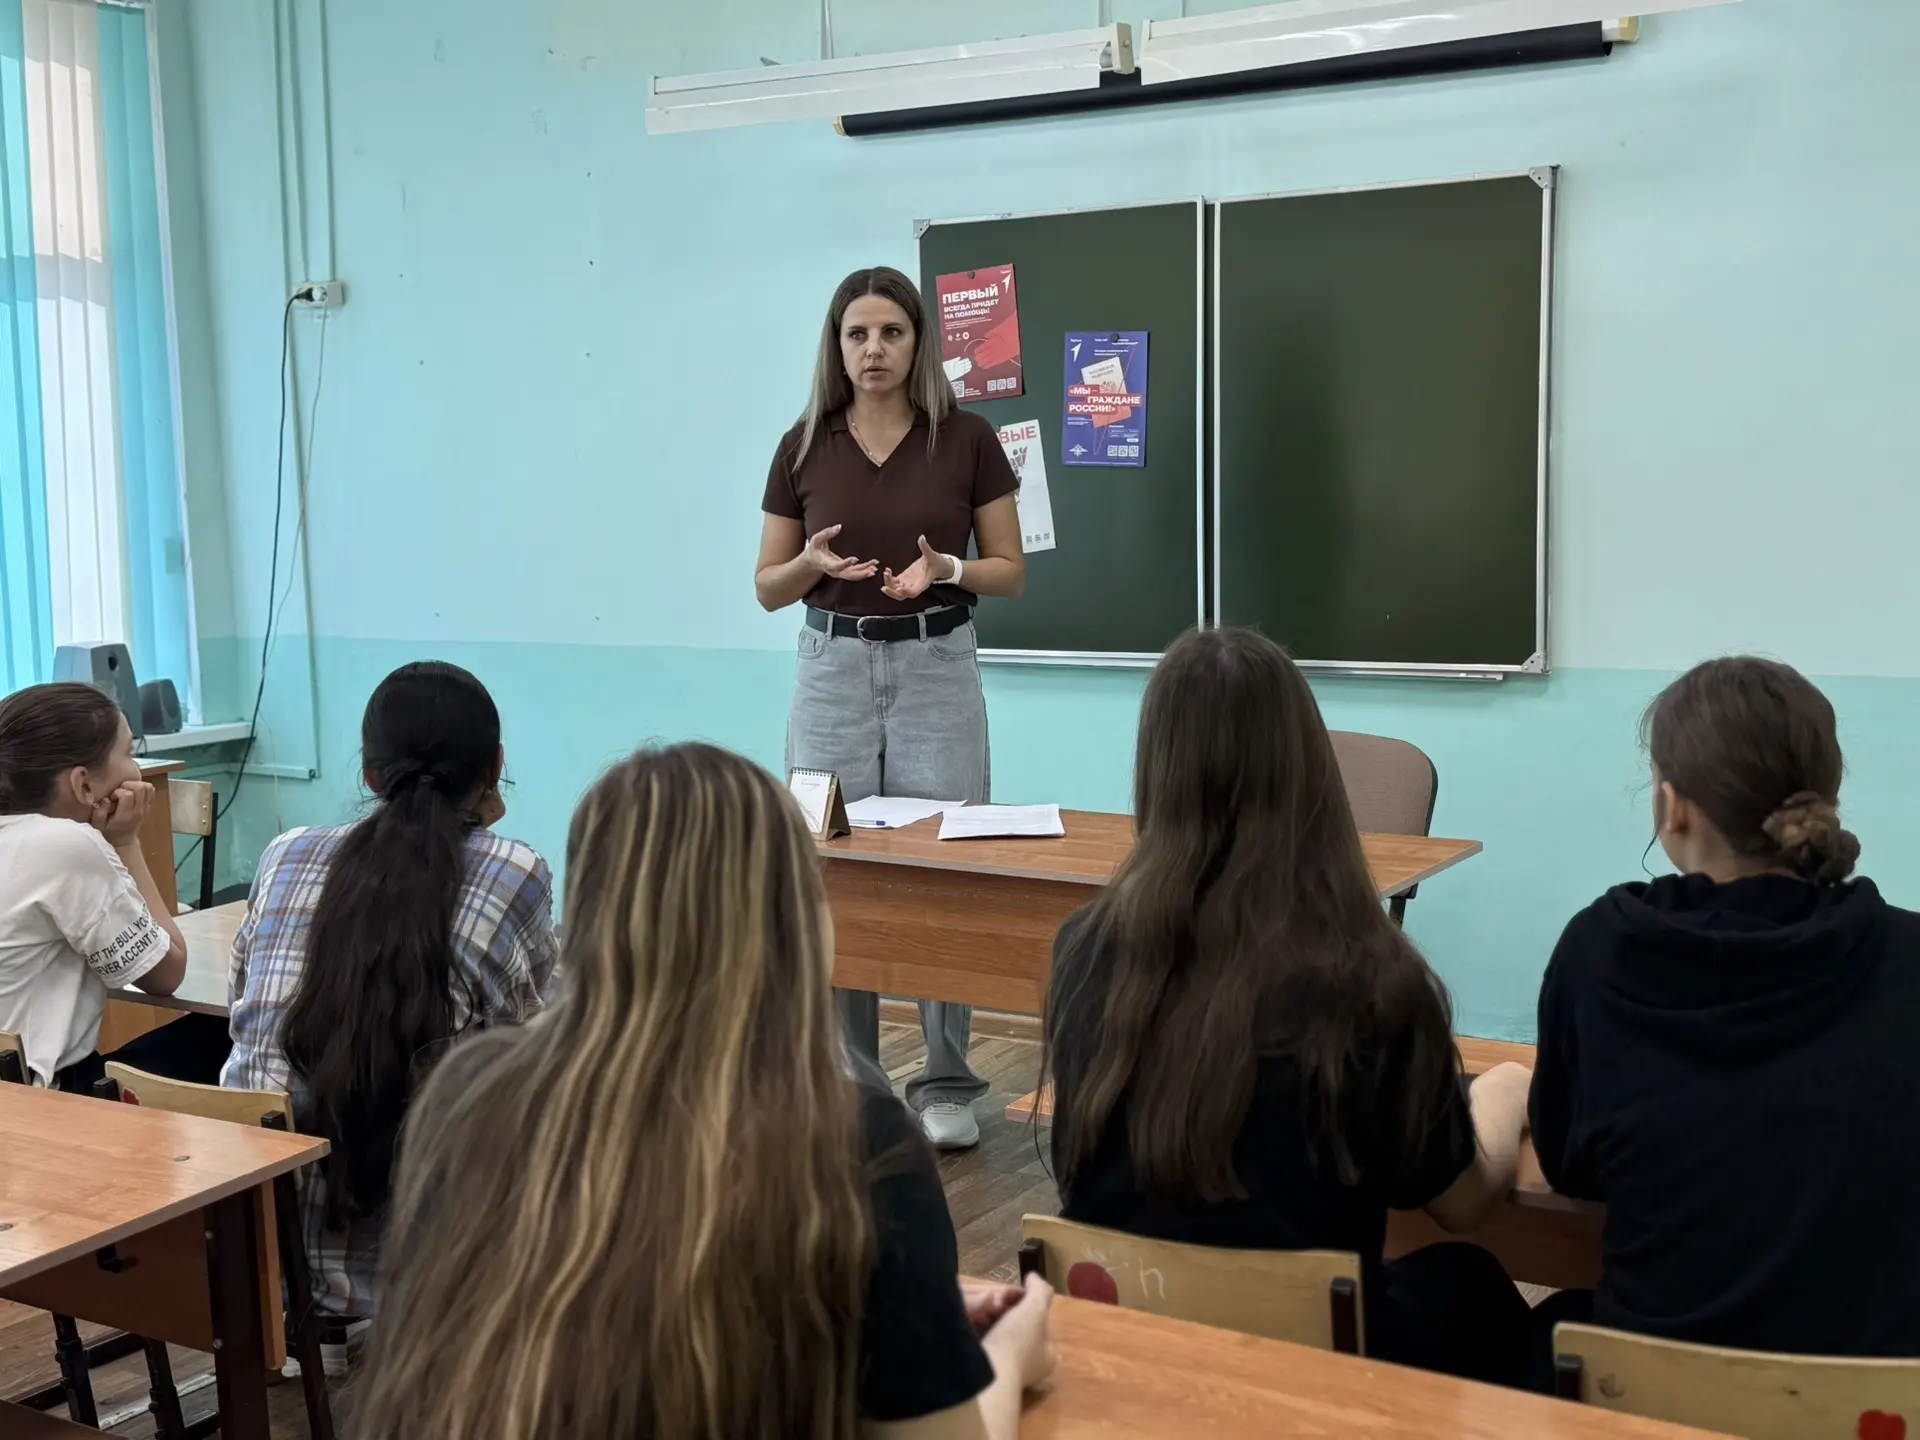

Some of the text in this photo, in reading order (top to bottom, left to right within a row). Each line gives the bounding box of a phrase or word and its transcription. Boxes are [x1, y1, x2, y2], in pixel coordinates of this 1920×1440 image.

[942, 284, 999, 305] ПЕРВЫЙ
[943, 303, 970, 313] ВСЕГДА
[944, 308, 990, 320] НА ПОМОЩЬ!
[1087, 396, 1141, 405] ГРАЖДАНЕ
[101, 941, 119, 960] THE
[115, 926, 138, 948] BULL
[120, 933, 153, 967] ACCENT
